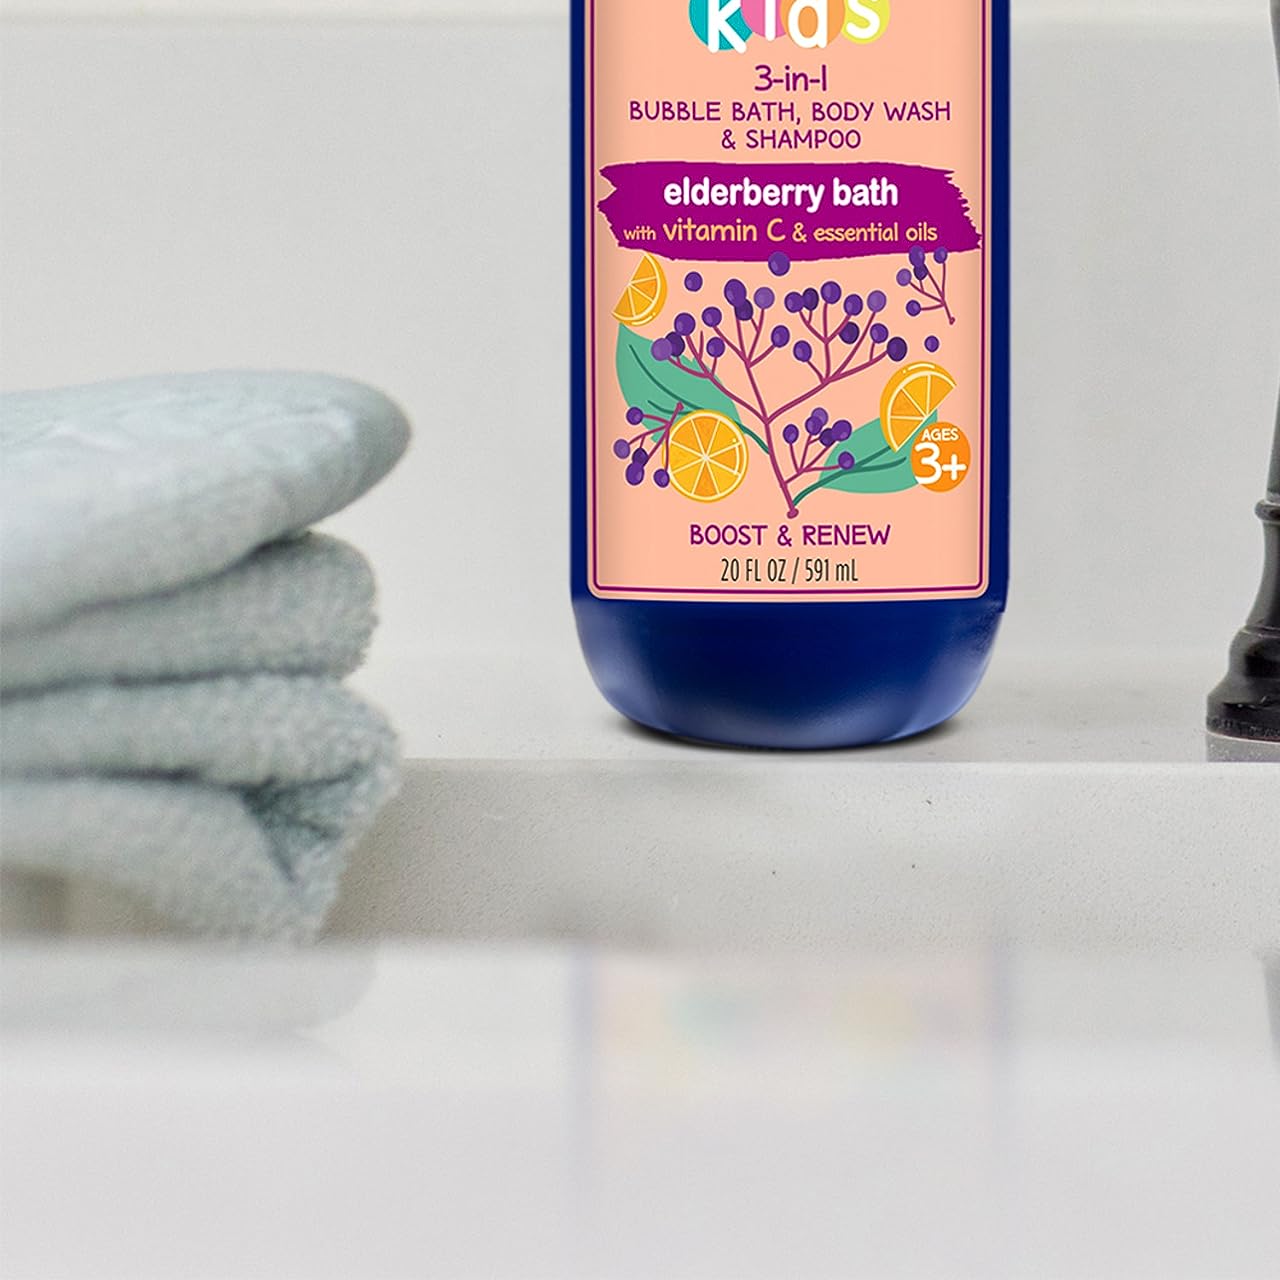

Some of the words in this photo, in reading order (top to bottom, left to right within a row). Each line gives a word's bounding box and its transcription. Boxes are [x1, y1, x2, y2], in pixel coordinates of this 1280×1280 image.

[629, 100, 721, 121] BUBBLE
[732, 102, 801, 125] BATH,
[812, 102, 874, 121] BODY
[883, 101, 951, 121] WASH
[721, 130, 737, 149] &
[746, 129, 861, 149] SHAMPOO
[663, 176, 825, 213] elderberry
[832, 176, 899, 207] bath
[624, 226, 656, 242] with
[663, 217, 758, 243] vitamin
[766, 218, 785, 242] C
[792, 226, 807, 243] &
[813, 222, 899, 243] essential
[905, 222, 938, 242] oils
[921, 428, 959, 442] AGES
[914, 442, 967, 484] 3+
[690, 524, 767, 546] BOOST
[777, 525, 792, 547] &
[802, 524, 891, 546] RENEW
[721, 558, 740, 582] 20
[745, 558, 761, 582] FL
[766, 558, 786, 583] OZ
[791, 557, 801, 584] /
[804, 558, 830, 583] 591
[835, 558, 859, 583] mL
